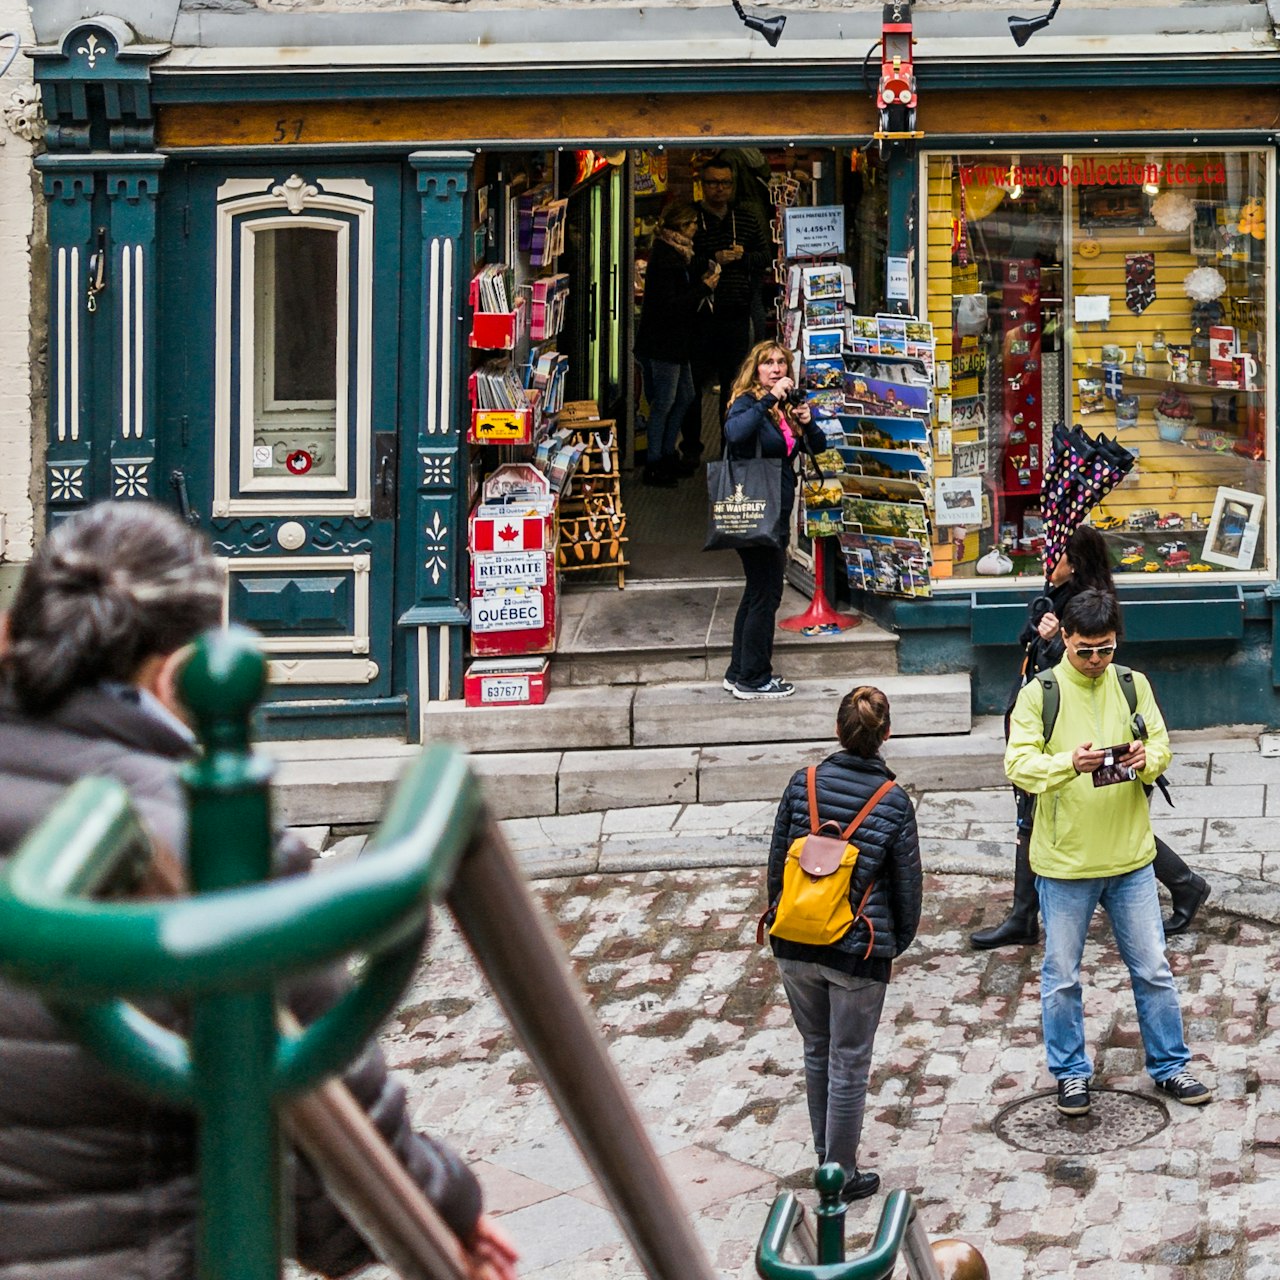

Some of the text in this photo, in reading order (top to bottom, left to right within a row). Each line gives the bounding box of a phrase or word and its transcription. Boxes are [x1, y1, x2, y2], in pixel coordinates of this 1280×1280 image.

[960, 158, 1227, 188] www.autocollection-tcc.ca
[478, 606, 538, 622] QUÉBEC
[487, 685, 523, 697] 637677
